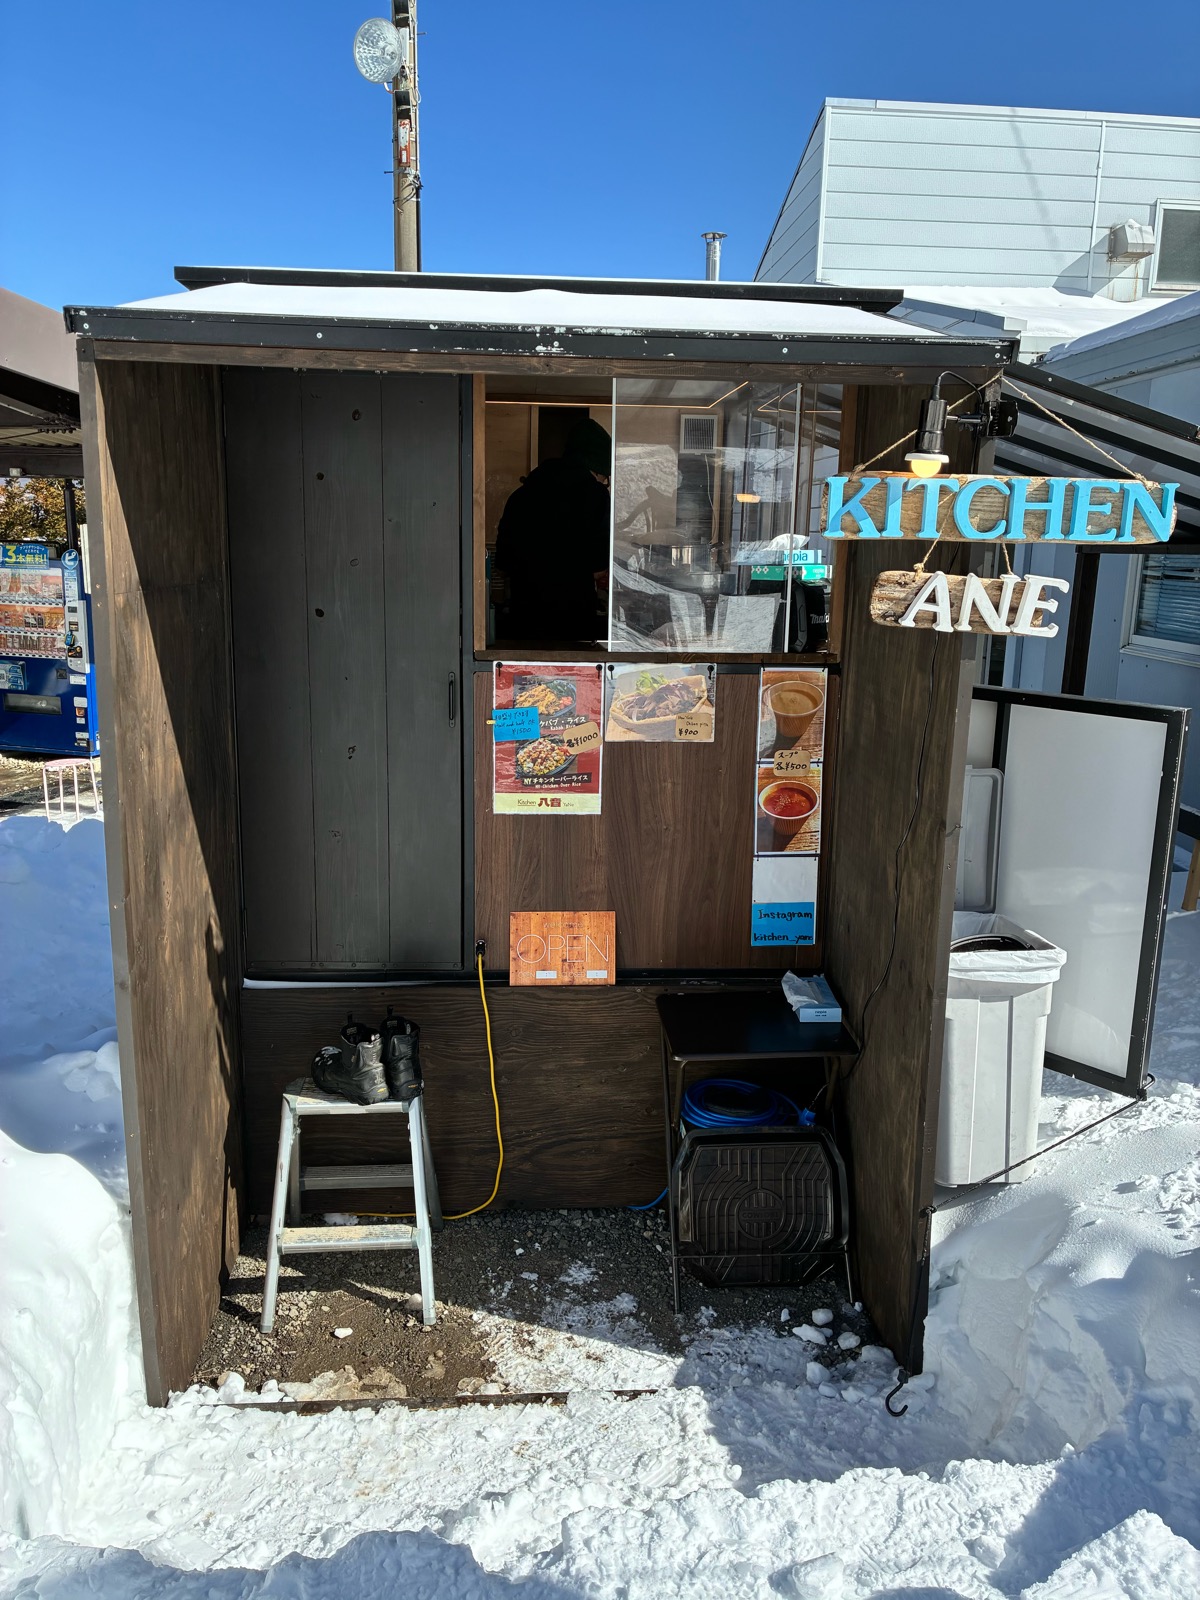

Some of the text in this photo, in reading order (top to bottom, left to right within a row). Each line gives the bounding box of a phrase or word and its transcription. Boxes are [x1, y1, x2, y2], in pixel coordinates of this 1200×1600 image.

[822, 476, 1180, 542] KITCHEN
[899, 571, 1070, 638] ANE
[758, 909, 813, 921] Instagram
[516, 934, 609, 963] OPEN
